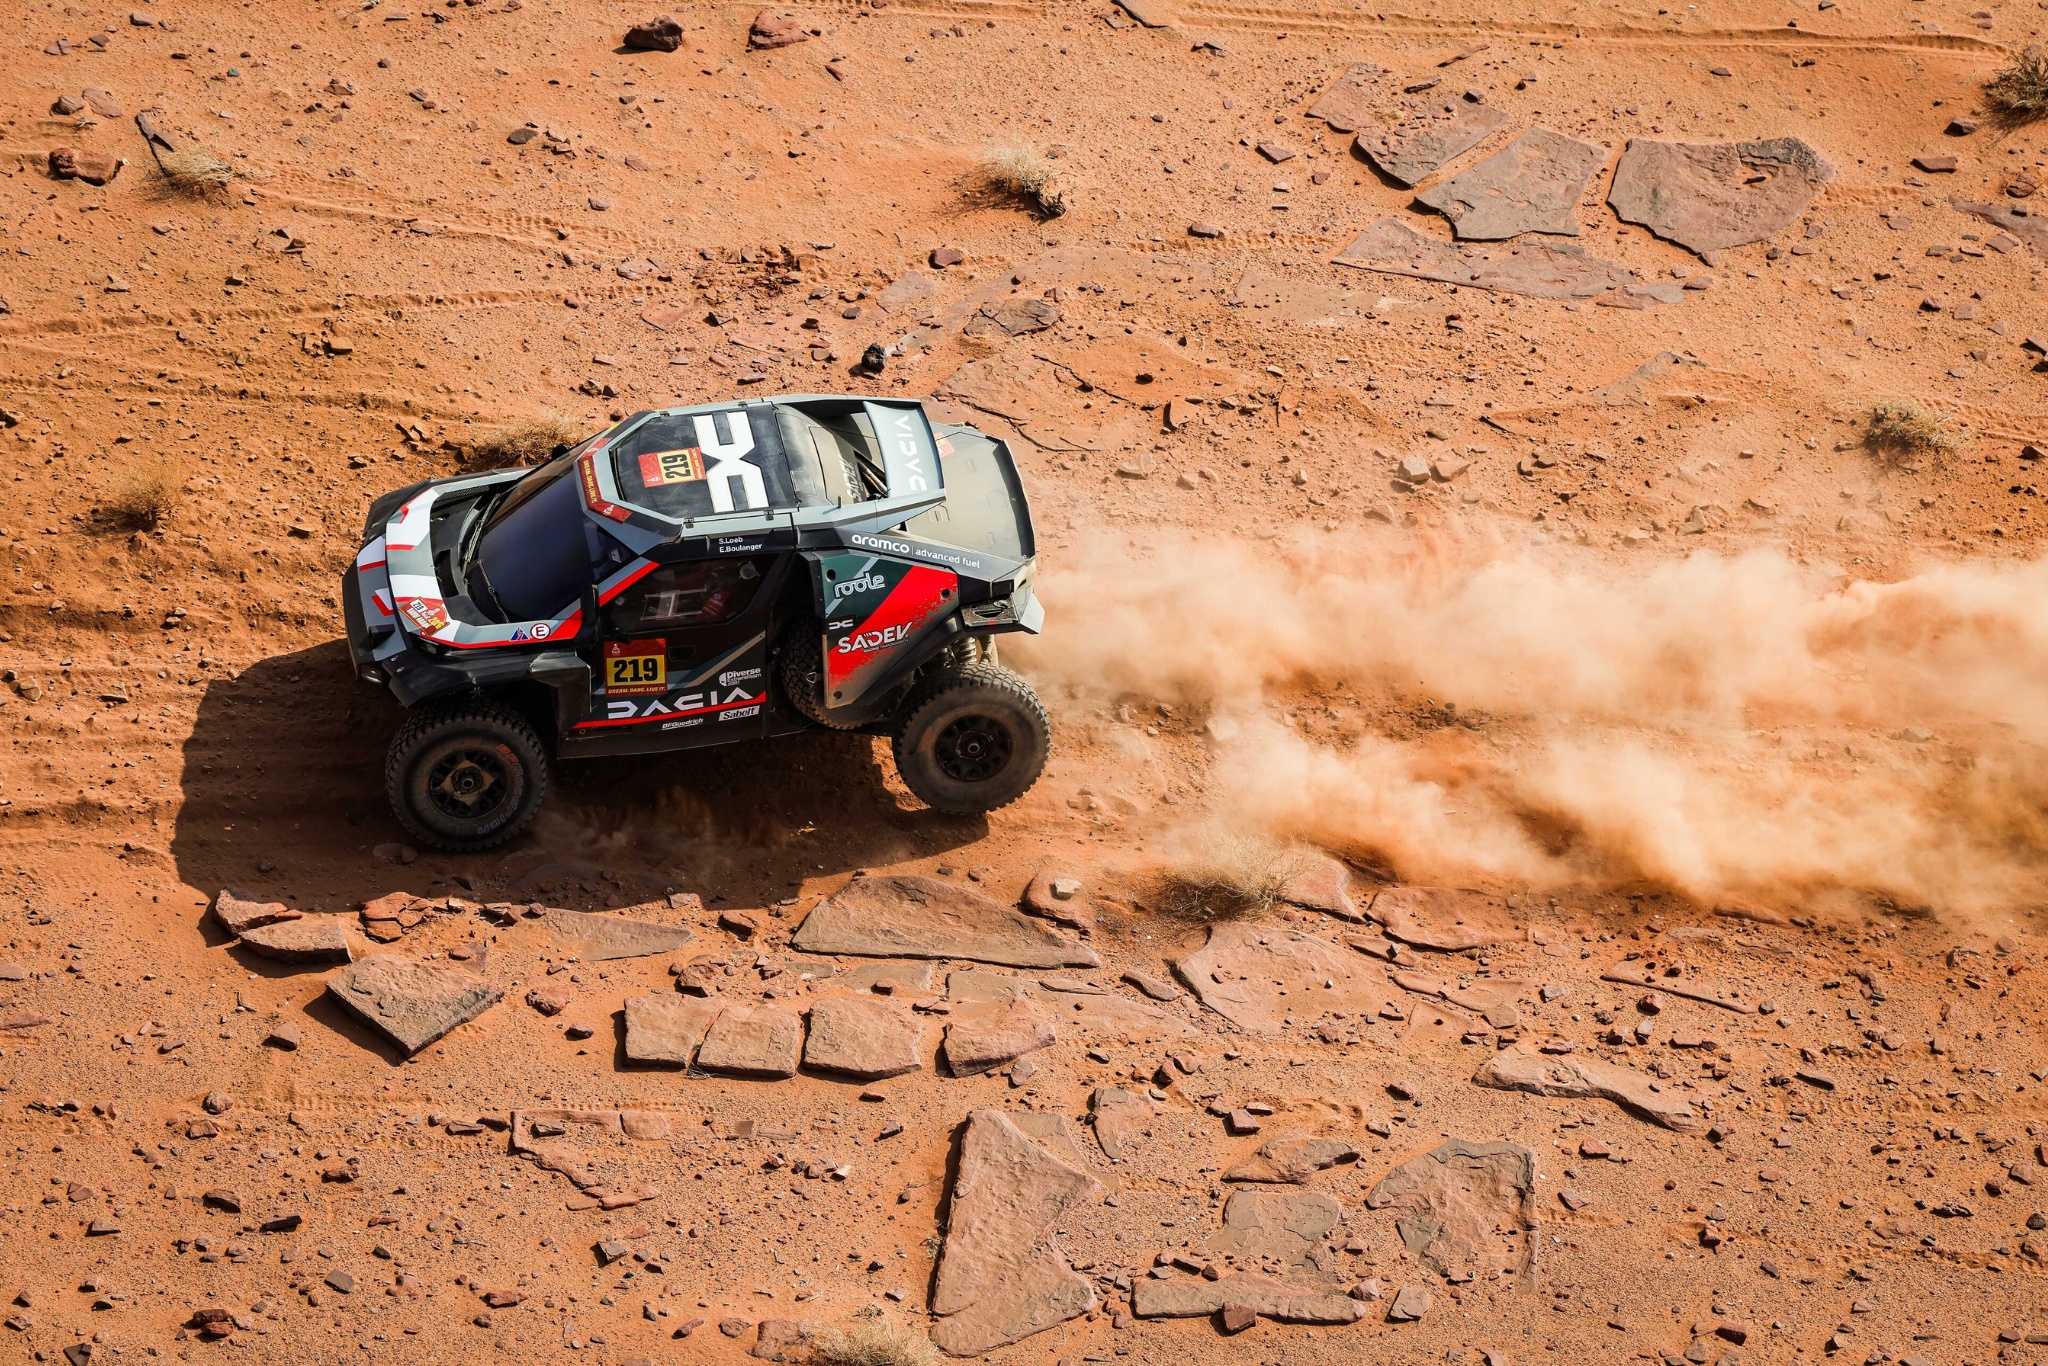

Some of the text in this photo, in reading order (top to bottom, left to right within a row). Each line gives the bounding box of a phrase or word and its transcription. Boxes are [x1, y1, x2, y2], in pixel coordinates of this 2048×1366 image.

[661, 453, 692, 479] 219
[719, 537, 743, 545] S.Loeb
[720, 544, 762, 553] E.Boulanger
[852, 534, 910, 553] aramco
[915, 548, 981, 568] advanced fuel
[834, 572, 886, 598] roole
[838, 622, 913, 654] SADEV
[613, 658, 658, 682] 219
[726, 668, 761, 678] Diverse
[607, 687, 754, 719] DACIA
[723, 708, 755, 719] Sabelt
[662, 717, 704, 730] BFGoodrich
